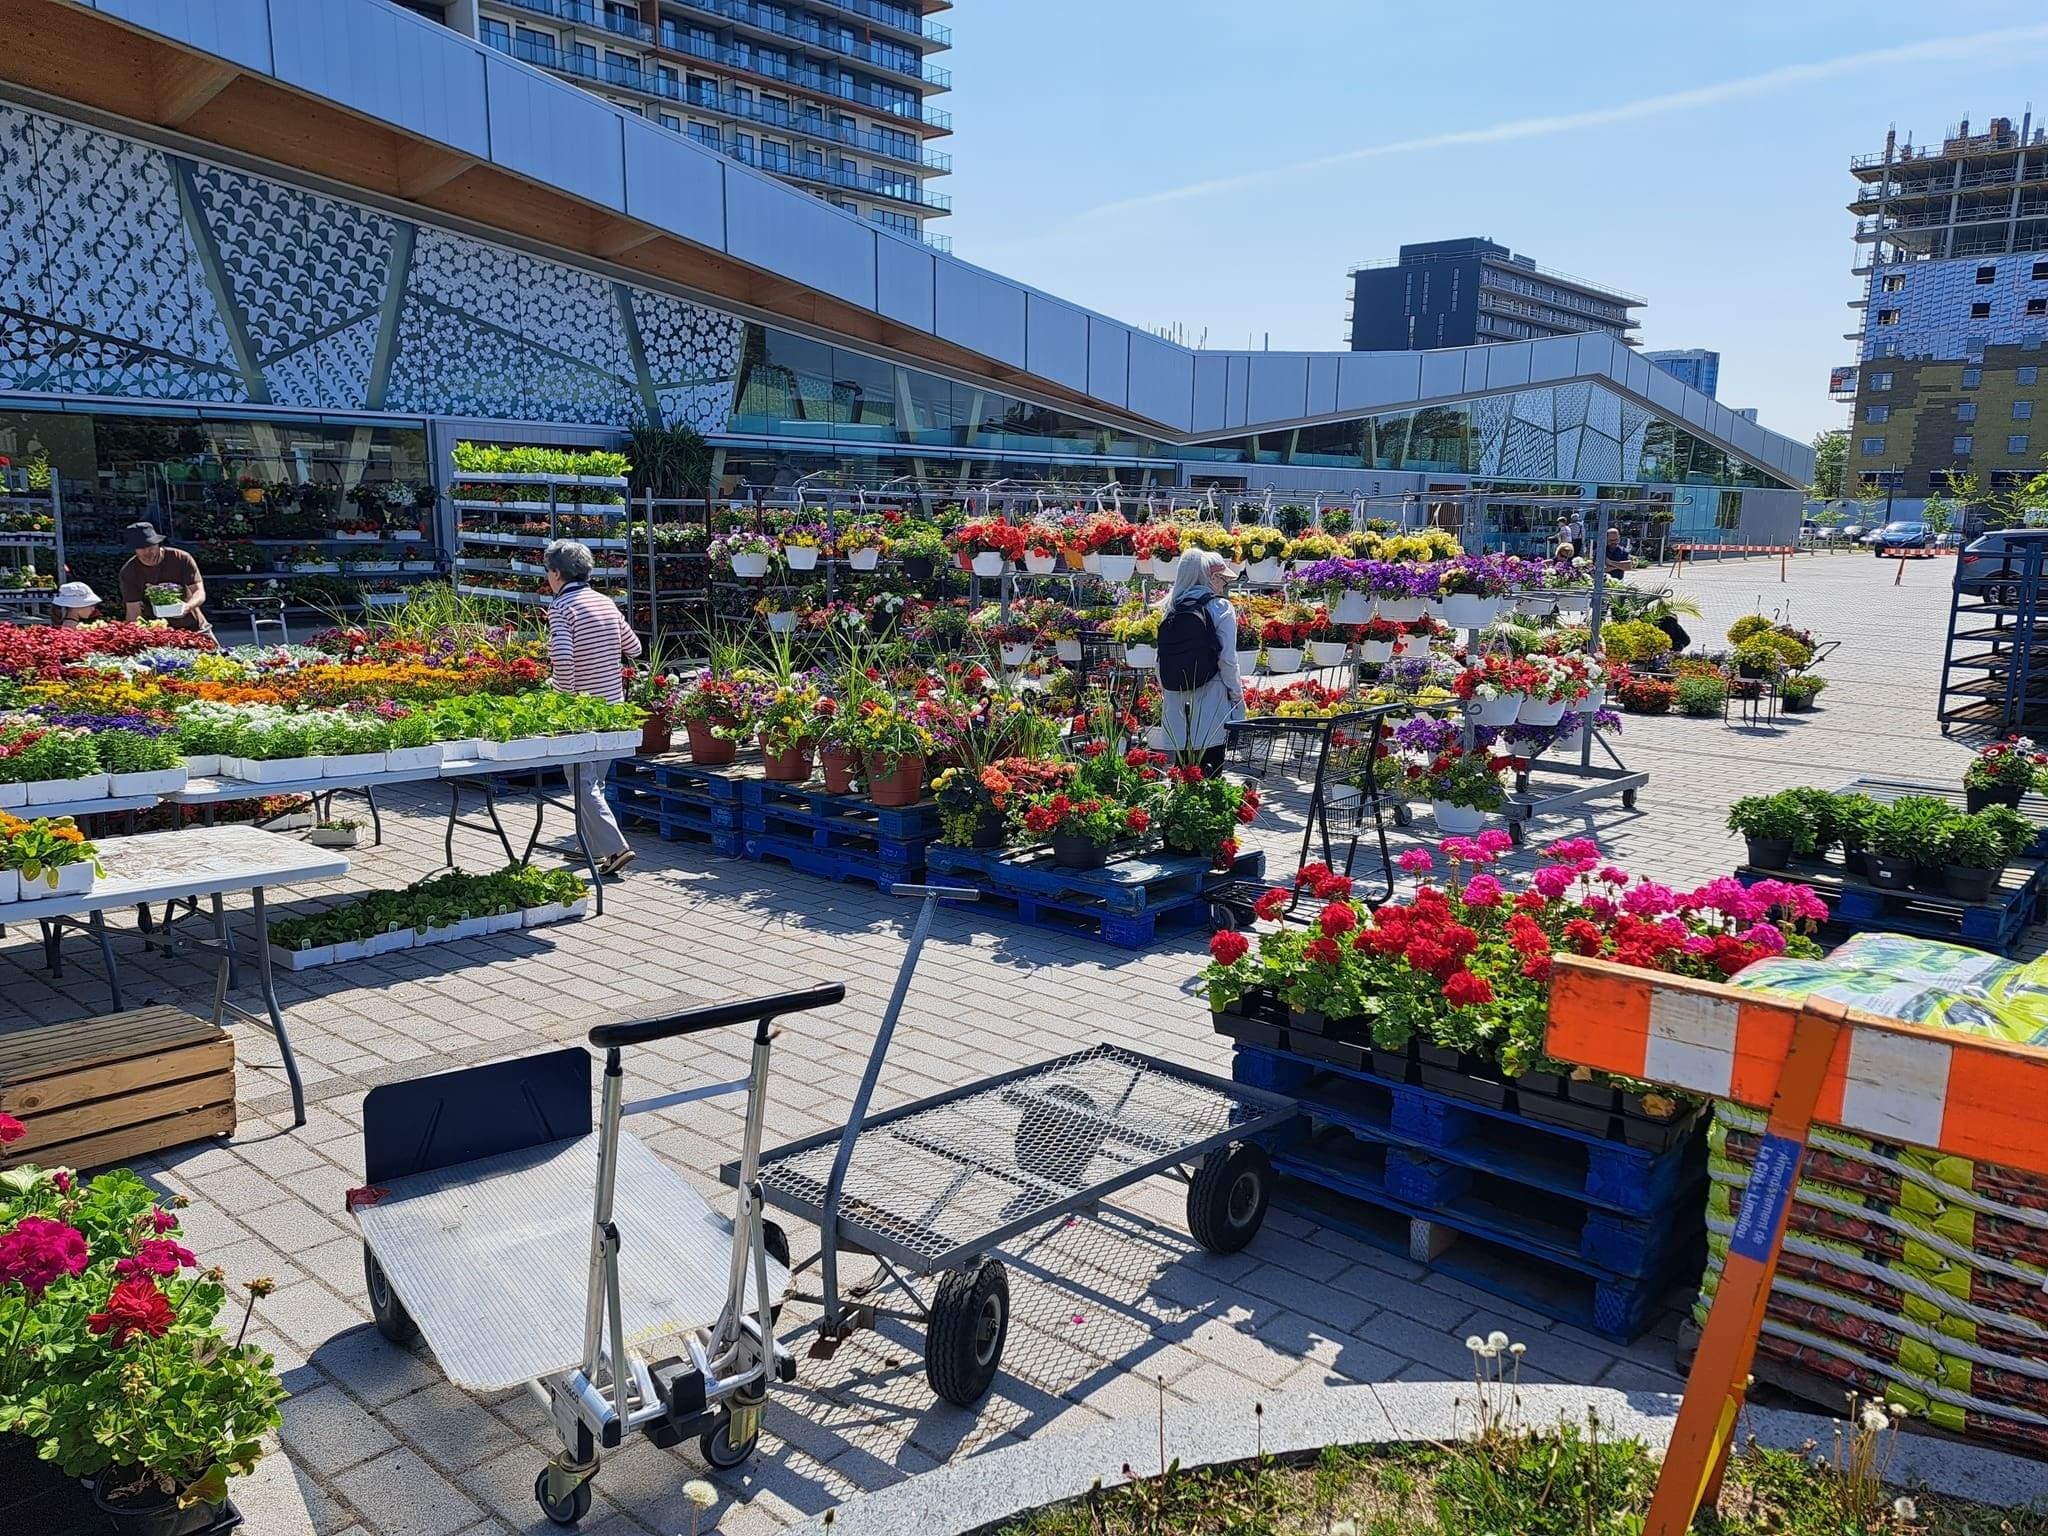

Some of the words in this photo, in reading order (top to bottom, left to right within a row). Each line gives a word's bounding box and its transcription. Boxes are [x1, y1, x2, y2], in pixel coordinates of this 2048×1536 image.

[1759, 1145, 1774, 1160] La
[1753, 1162, 1769, 1185] Cité
[1758, 1151, 1788, 1229] Arrondissement
[1736, 1193, 1761, 1239] Limoilou
[1752, 1232, 1767, 1245] de
[561, 1381, 579, 1404] COSCO
